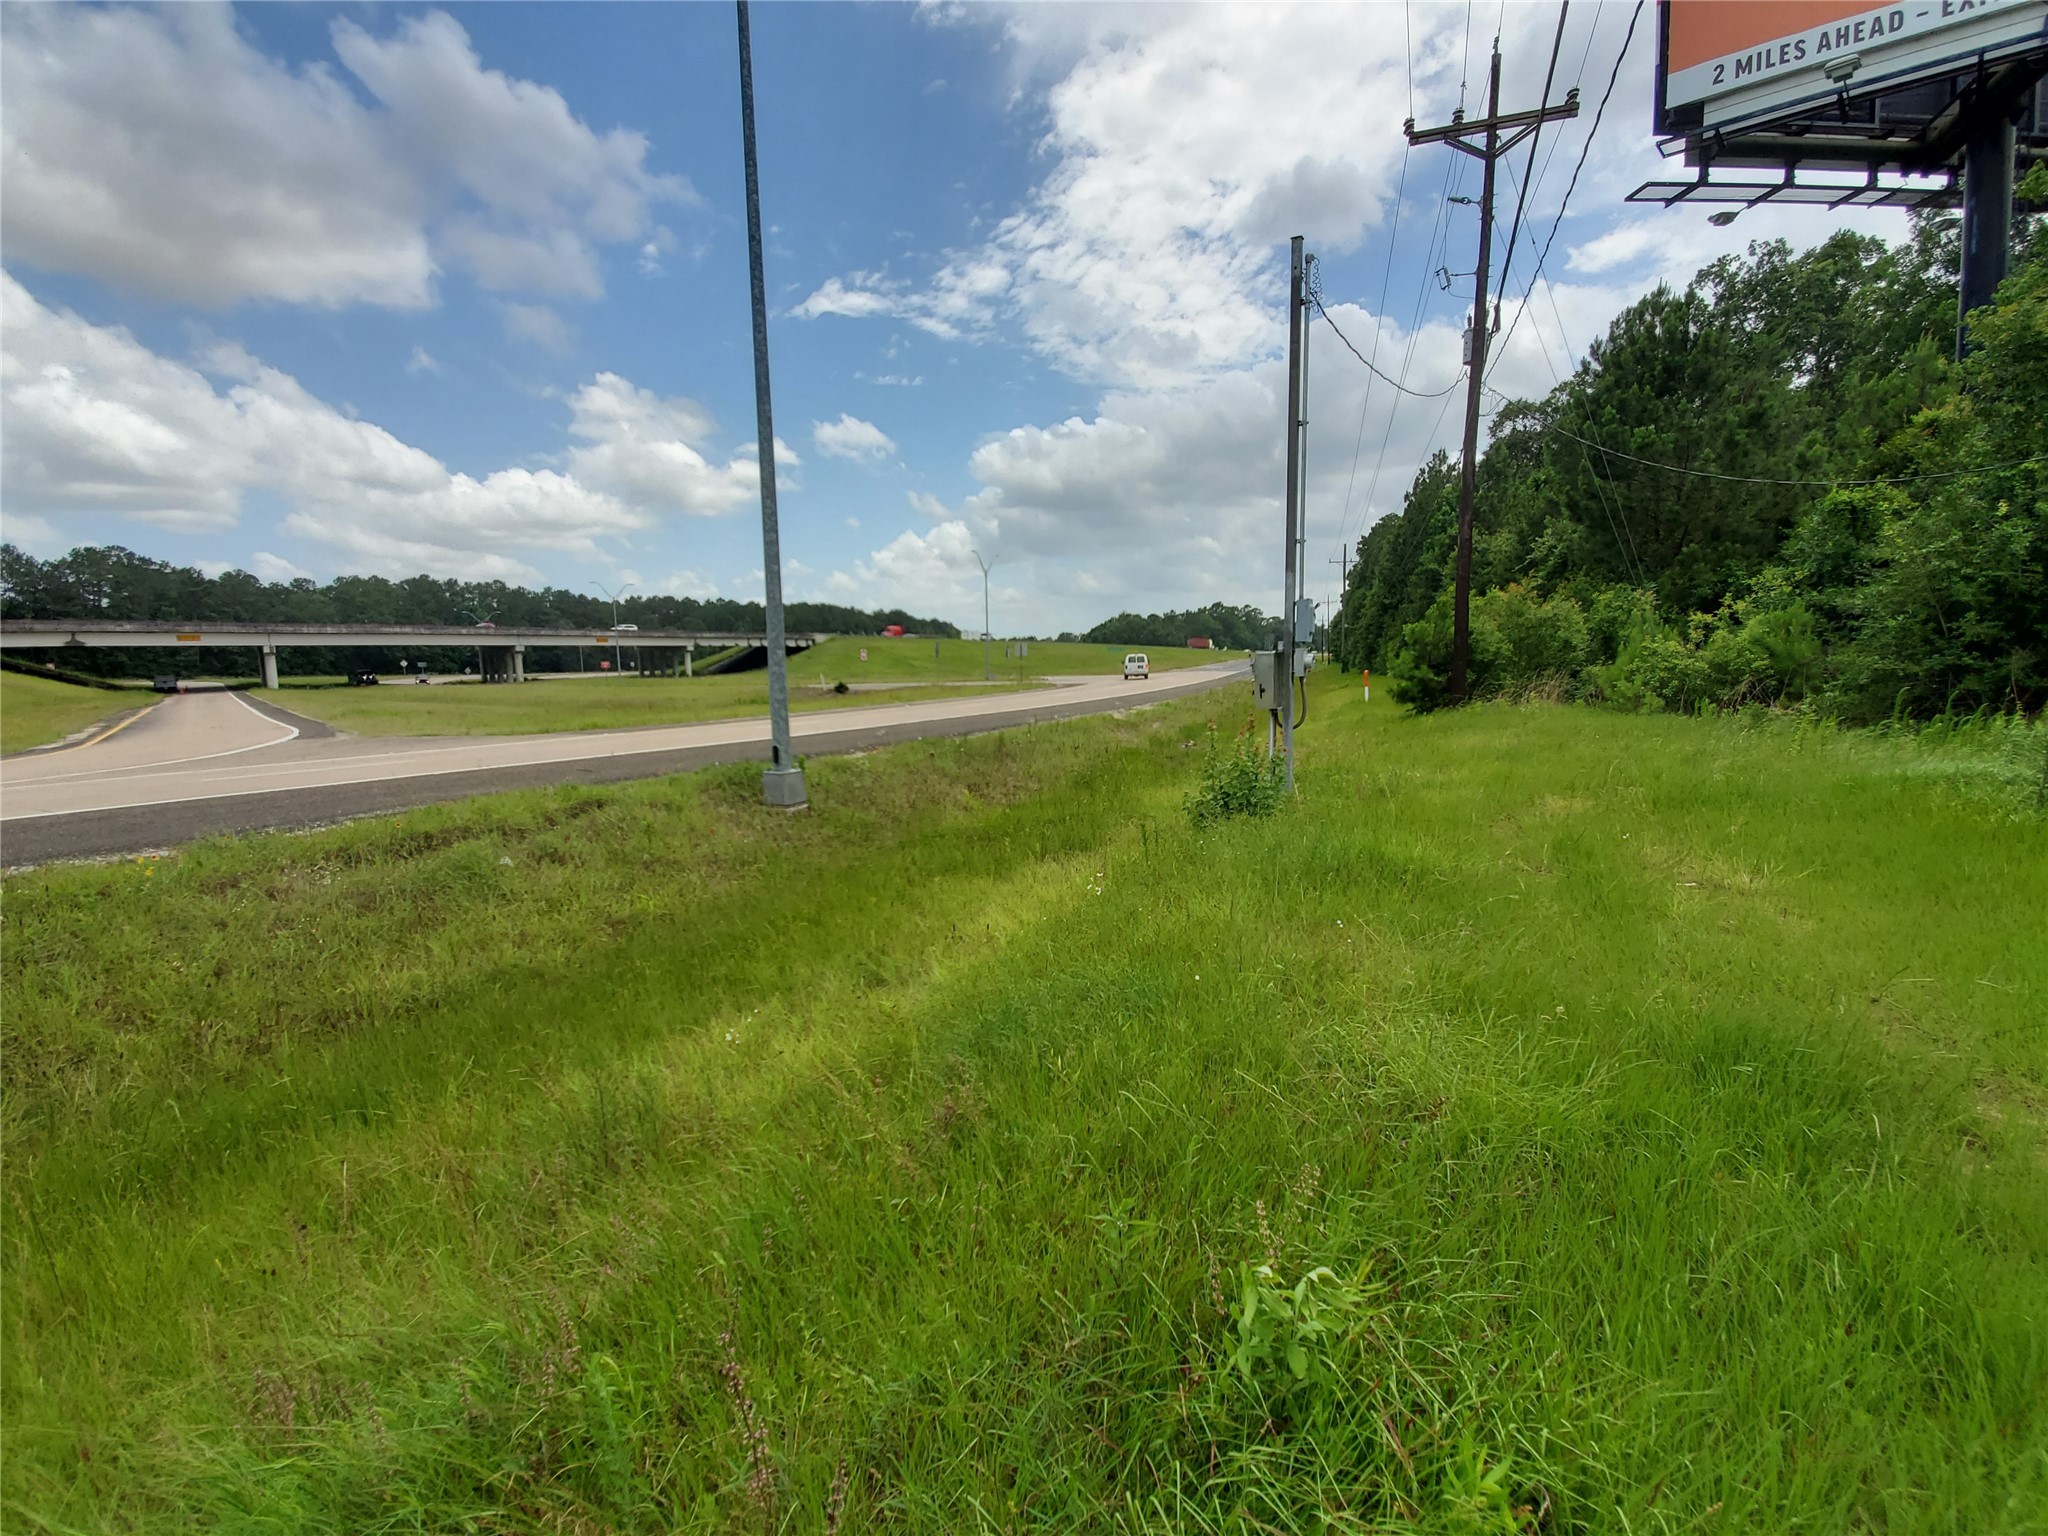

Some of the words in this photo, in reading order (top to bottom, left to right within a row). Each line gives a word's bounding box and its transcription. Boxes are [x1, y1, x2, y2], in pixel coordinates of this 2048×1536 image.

[1712, 64, 1725, 86] 2
[1735, 39, 1807, 80] MILES
[1816, 10, 1904, 55] AHEAD
